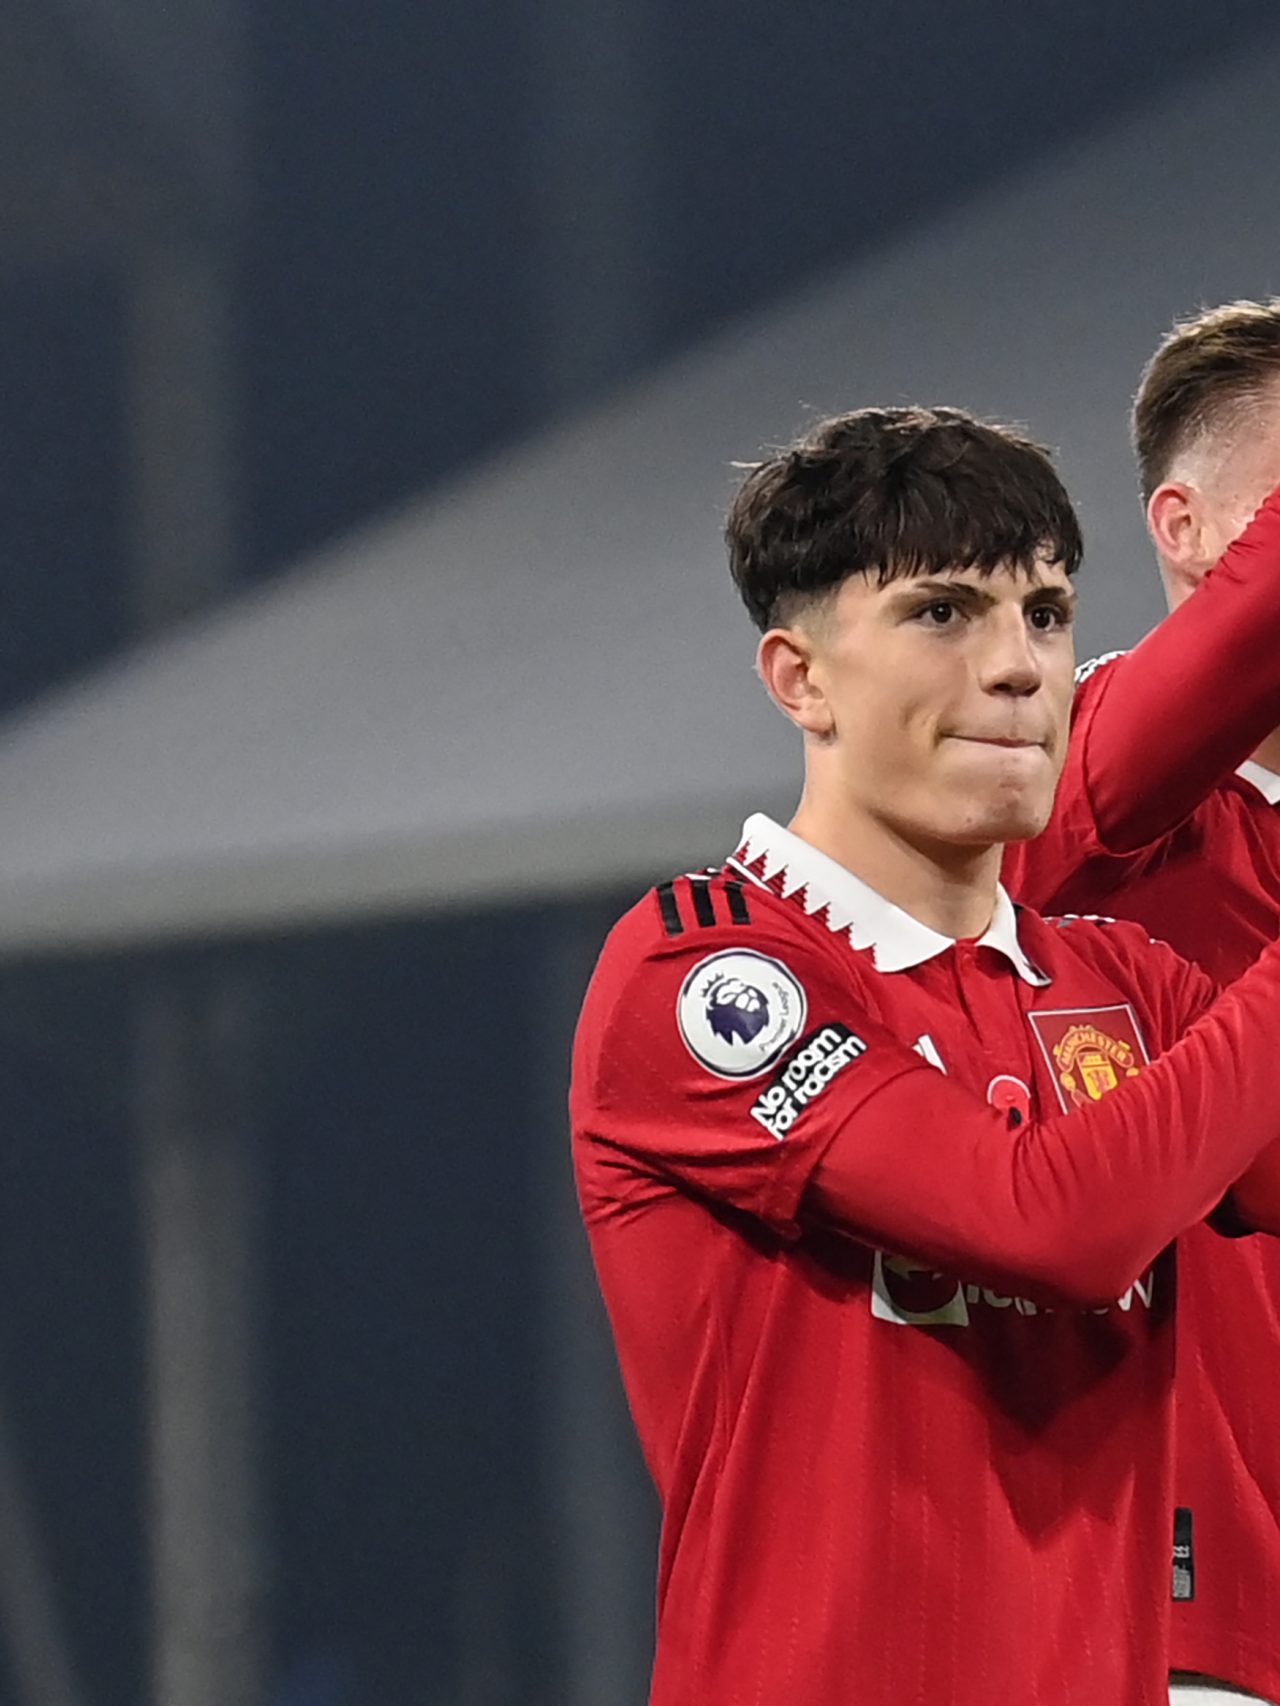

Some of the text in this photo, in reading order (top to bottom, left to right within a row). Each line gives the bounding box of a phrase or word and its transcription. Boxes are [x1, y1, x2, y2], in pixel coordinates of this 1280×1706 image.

[771, 982, 789, 1016] League
[750, 1029, 842, 1127] No room
[767, 1036, 867, 1140] for racism
